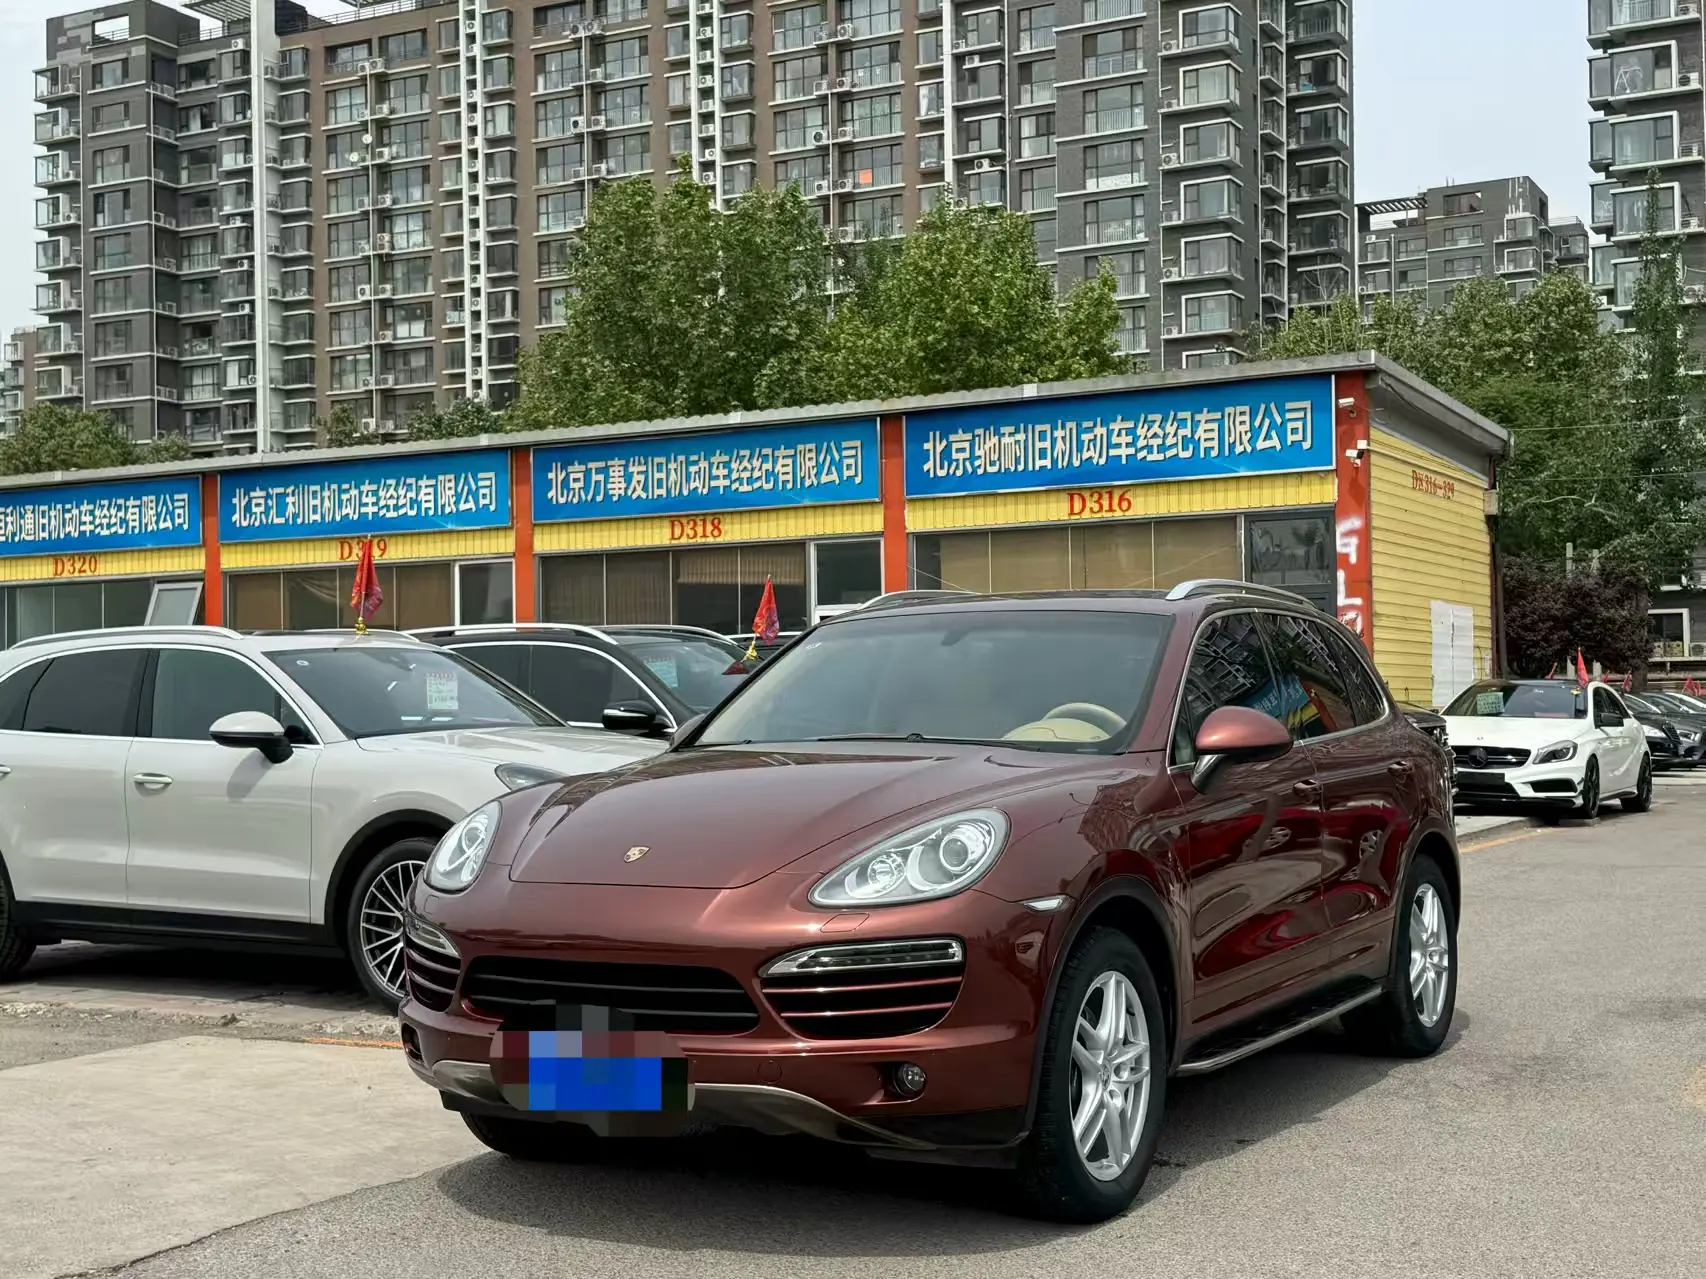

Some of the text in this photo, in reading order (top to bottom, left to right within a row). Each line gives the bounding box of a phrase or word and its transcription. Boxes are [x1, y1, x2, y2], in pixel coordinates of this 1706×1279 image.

[922, 399, 1313, 478] 北京驰耐旧机动车经纪有限公司
[547, 439, 864, 505] 北京万事发旧机动车经纪有限公司
[231, 470, 497, 527] 北京汇利旧机动车经纪有限公司
[1067, 489, 1132, 516] D316
[670, 517, 723, 541] D318
[339, 537, 388, 560] D39
[53, 555, 99, 577] D320
